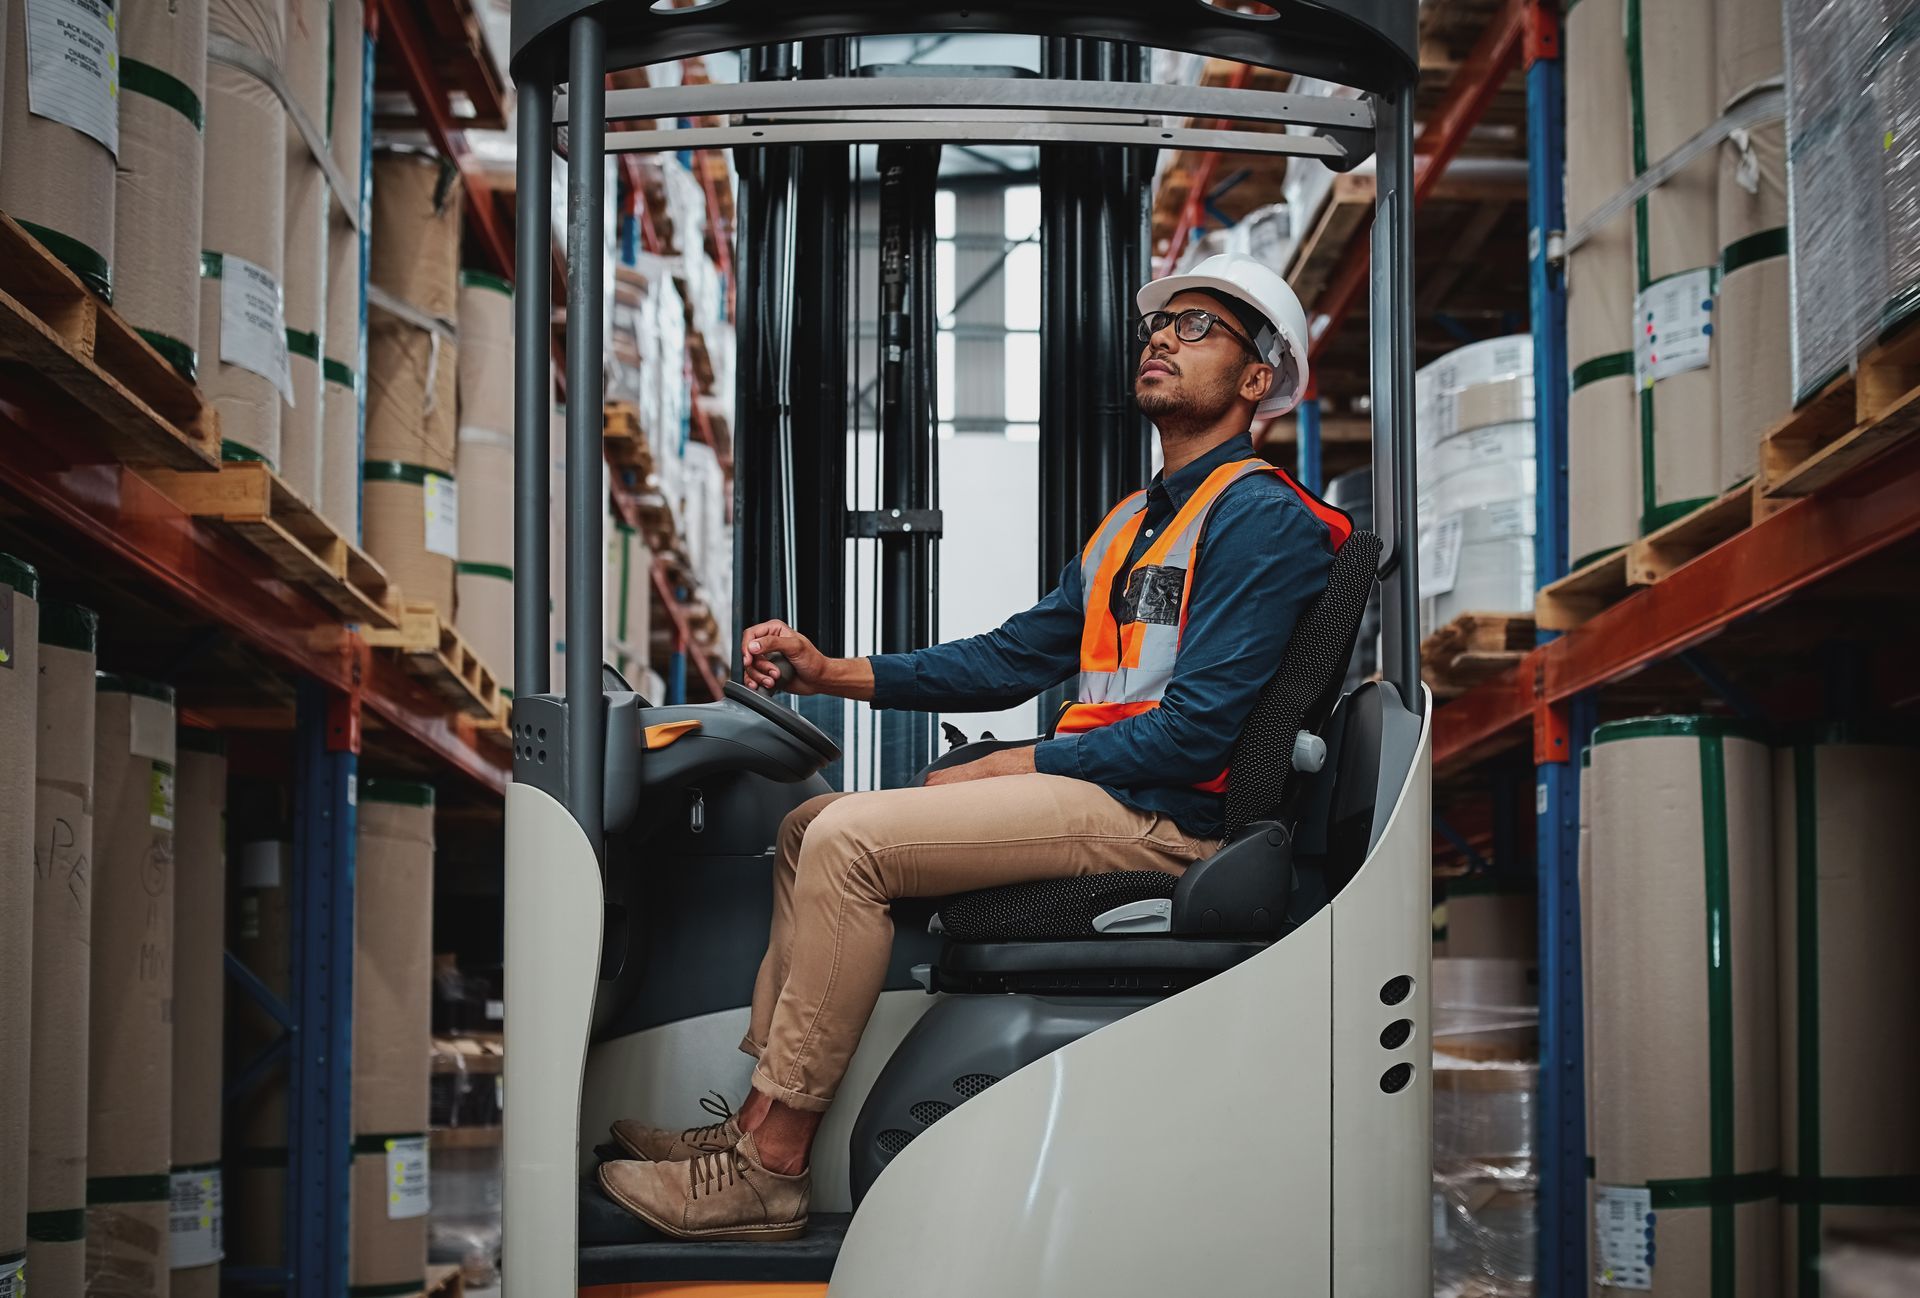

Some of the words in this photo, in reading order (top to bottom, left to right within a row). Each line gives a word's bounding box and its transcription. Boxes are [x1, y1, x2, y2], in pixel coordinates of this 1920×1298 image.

[56, 18, 80, 34] BLACK
[64, 53, 79, 65] PVC
[68, 48, 99, 70] CHARCOAL
